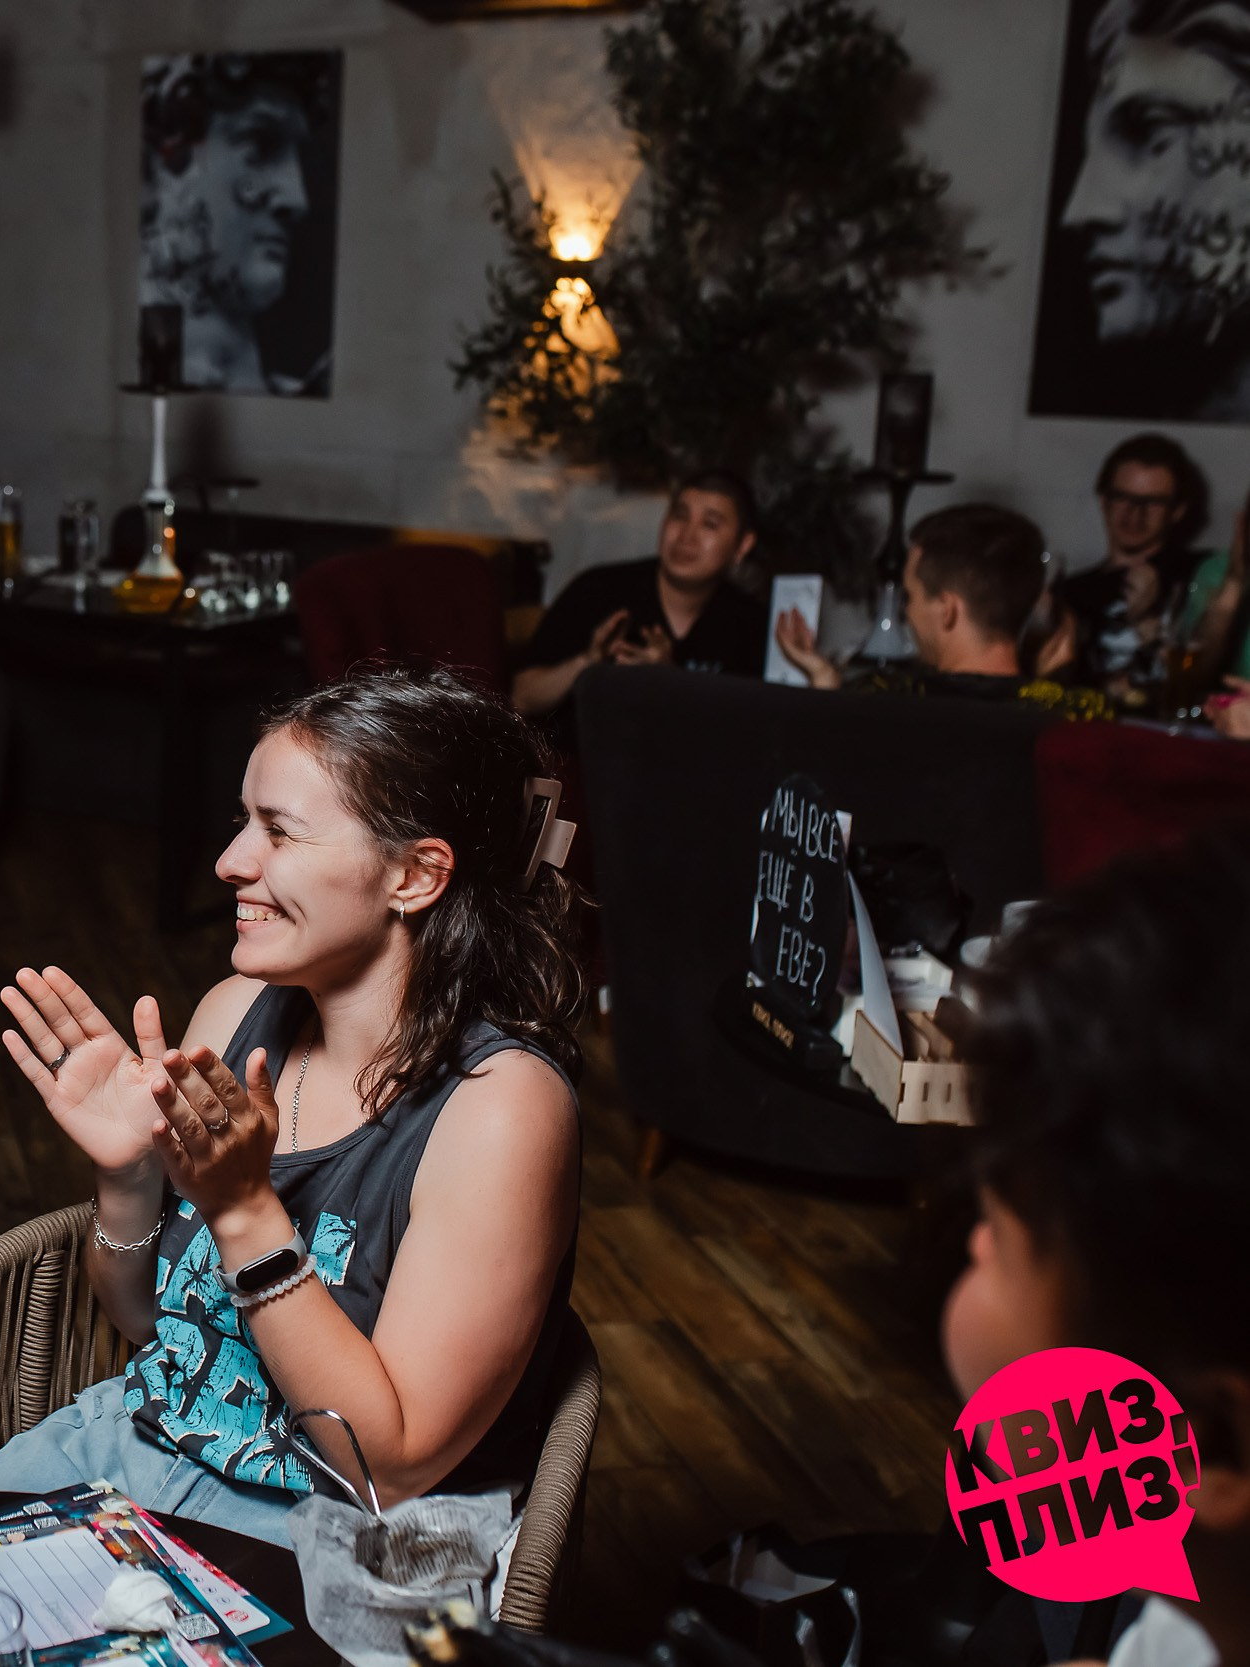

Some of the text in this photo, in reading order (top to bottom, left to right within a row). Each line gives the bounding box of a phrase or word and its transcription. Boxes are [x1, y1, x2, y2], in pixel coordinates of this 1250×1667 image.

[770, 787, 805, 848] МЫ
[799, 874, 815, 923] В
[776, 924, 827, 1007] ЕВЕ?
